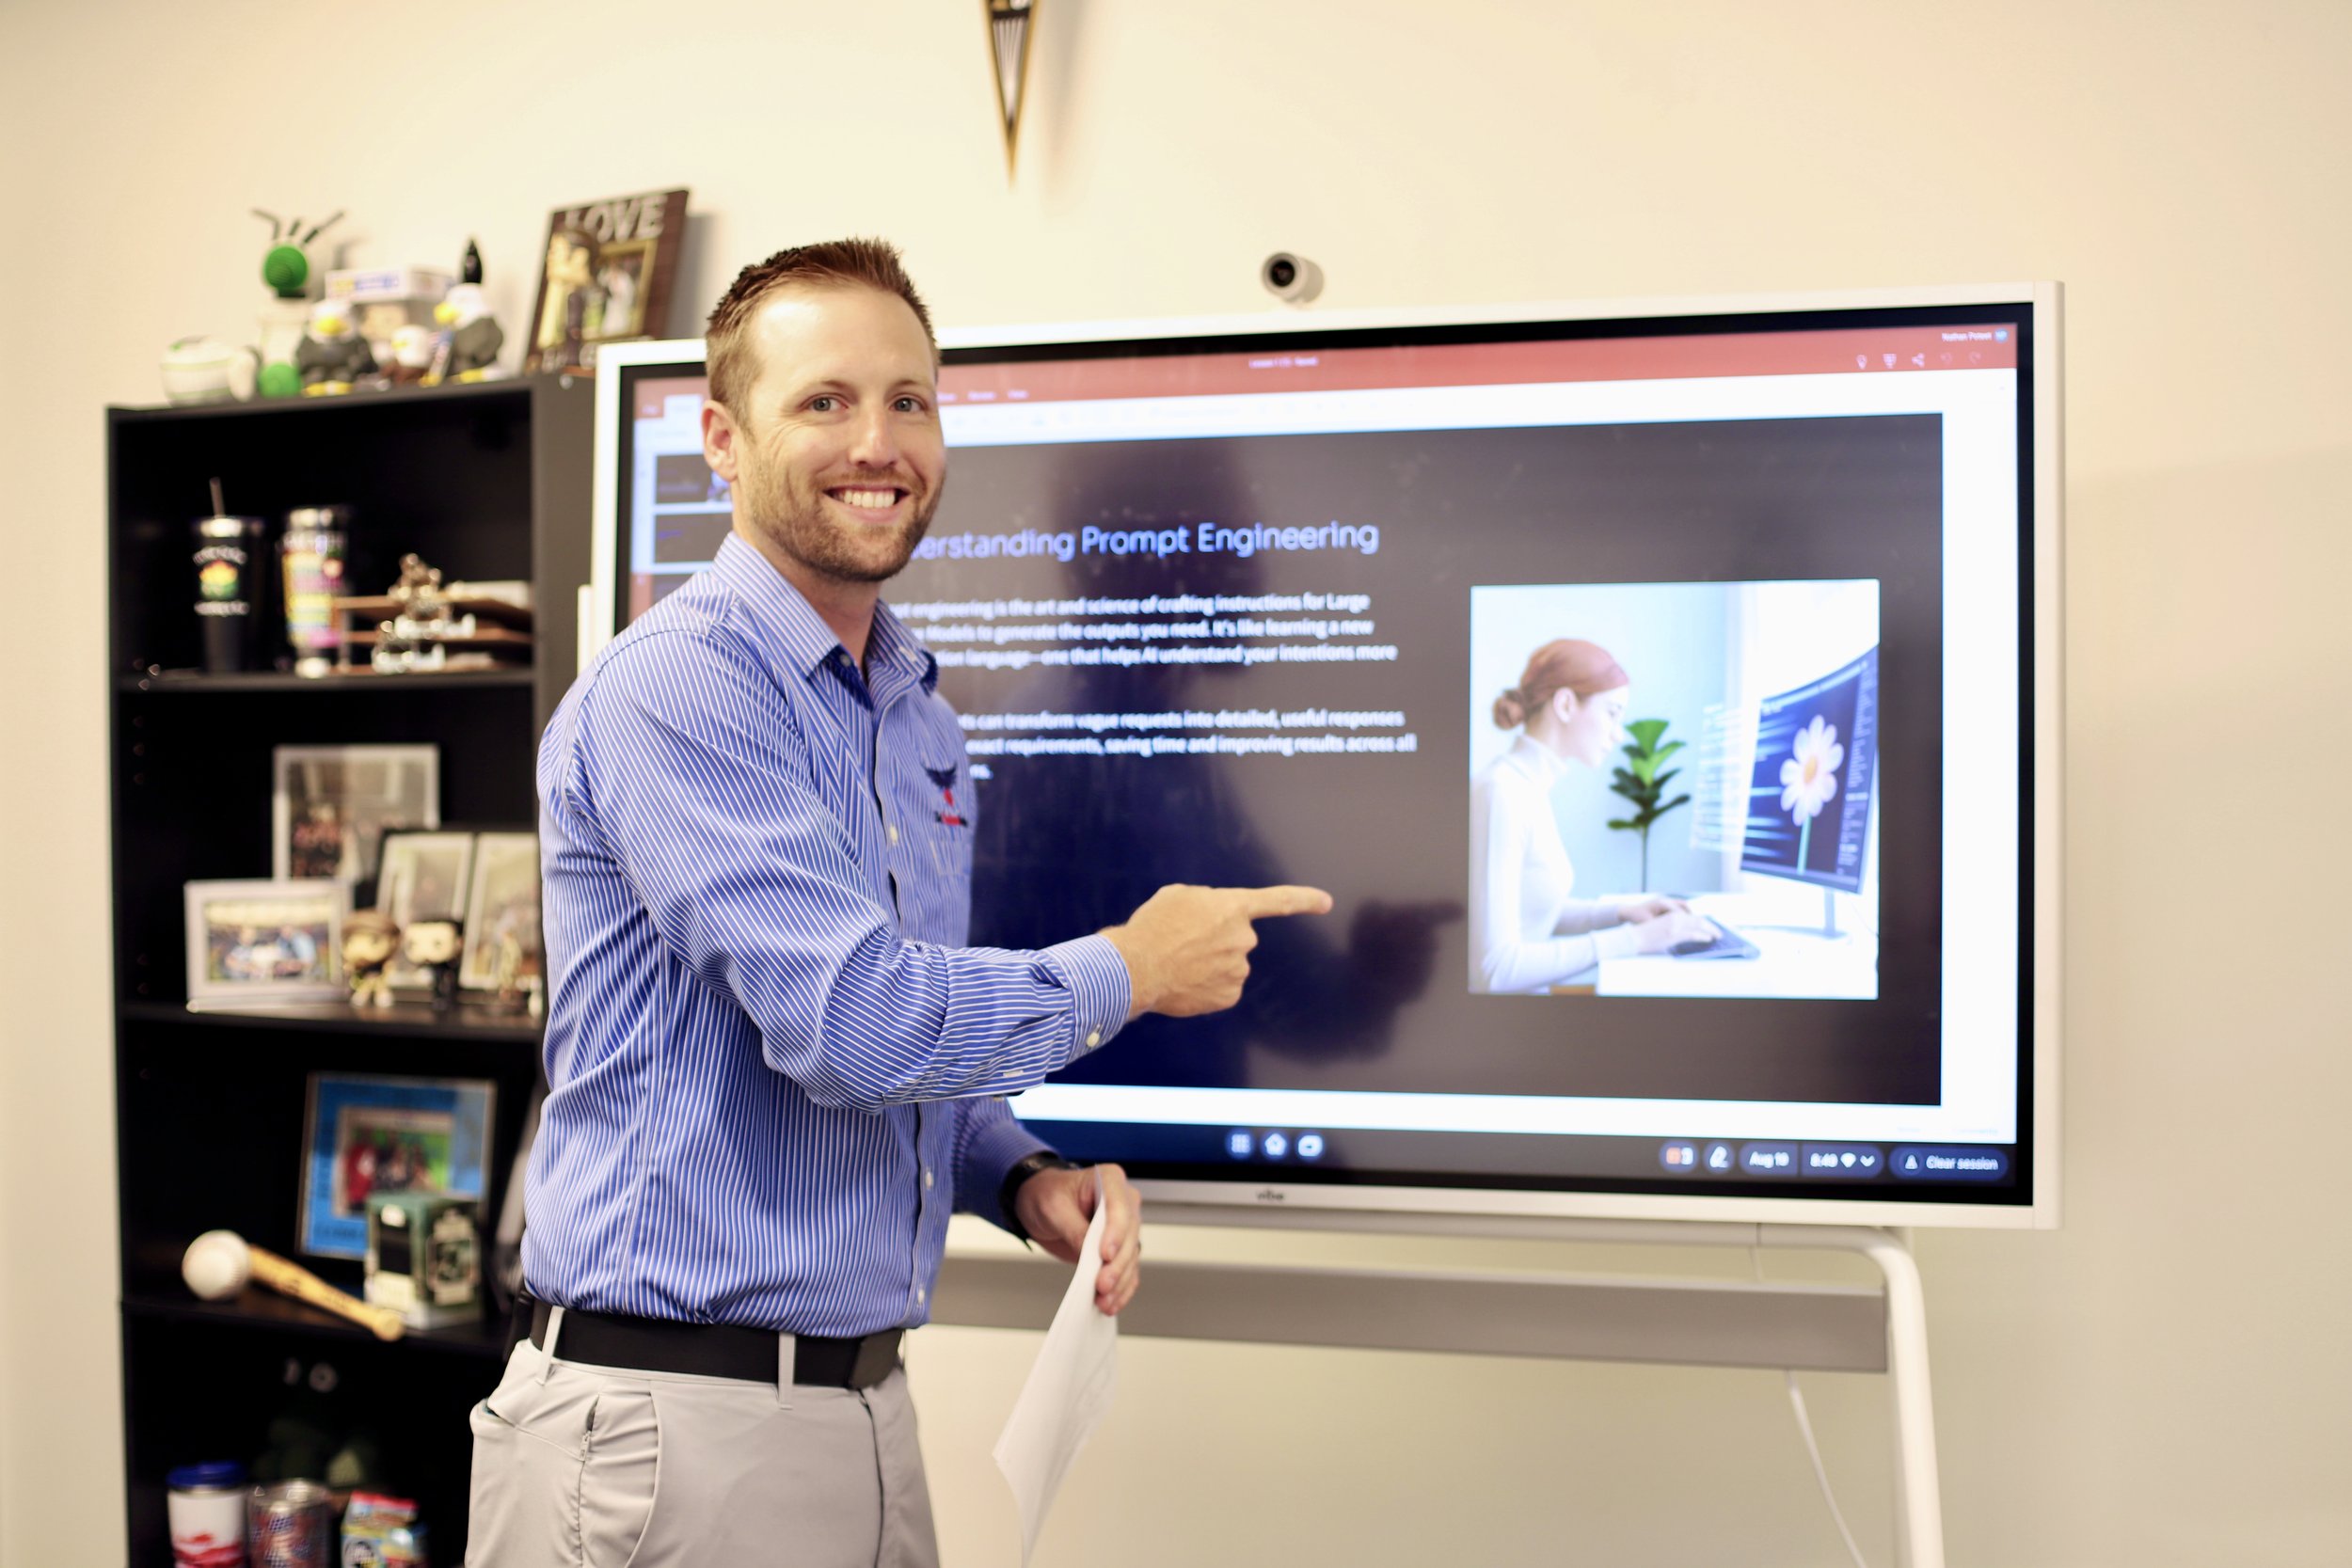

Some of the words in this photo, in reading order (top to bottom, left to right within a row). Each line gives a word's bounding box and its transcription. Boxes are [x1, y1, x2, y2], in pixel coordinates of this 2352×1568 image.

[1082, 524, 1191, 561] Prompt
[1198, 520, 1379, 558] Engineering
[912, 600, 994, 621] engineering
[994, 598, 1007, 617] is
[1008, 596, 1033, 617] the
[1035, 598, 1057, 616] art
[1057, 595, 1086, 615] and
[1087, 595, 1139, 615] science
[1140, 594, 1158, 614] of
[1158, 594, 1215, 616] crafting
[1216, 594, 1303, 612] instructions
[1303, 591, 1326, 610] for
[1327, 592, 1371, 614] Large
[925, 624, 976, 642] Models
[977, 624, 993, 641] to
[993, 624, 1057, 645] generate
[1058, 622, 1083, 641] the
[1084, 622, 1140, 643] outputs
[1141, 622, 1169, 642] you
[1170, 618, 1213, 639] need.
[1237, 617, 1265, 637] like
[1266, 617, 1328, 640] learning
[1328, 620, 1340, 637] a
[1340, 620, 1375, 636] new
[1071, 645, 1101, 666] that
[1102, 644, 1141, 668] helps
[1142, 645, 1158, 664] AI
[1159, 644, 1243, 664] understand
[1244, 644, 1278, 666] your
[1279, 642, 1356, 662] intentions
[1356, 644, 1398, 661] more
[977, 713, 1004, 731] can
[1005, 709, 1075, 730] transform
[1076, 712, 1120, 733] vague
[1120, 710, 1183, 733] requests
[1184, 708, 1215, 728] into
[1281, 706, 1327, 728] useful
[1328, 710, 1406, 731] responses
[1006, 736, 1104, 758] requirements,
[1105, 734, 1152, 758] saving
[1152, 735, 1186, 754] time
[1187, 733, 1217, 753] and
[1218, 734, 1295, 757] improving
[1295, 733, 1345, 752] results
[1346, 736, 1396, 752] across
[1396, 732, 1417, 752] all
[1749, 1150, 1774, 1168] Aug
[1926, 1154, 1956, 1170] Clear
[1957, 1156, 1999, 1170] session
